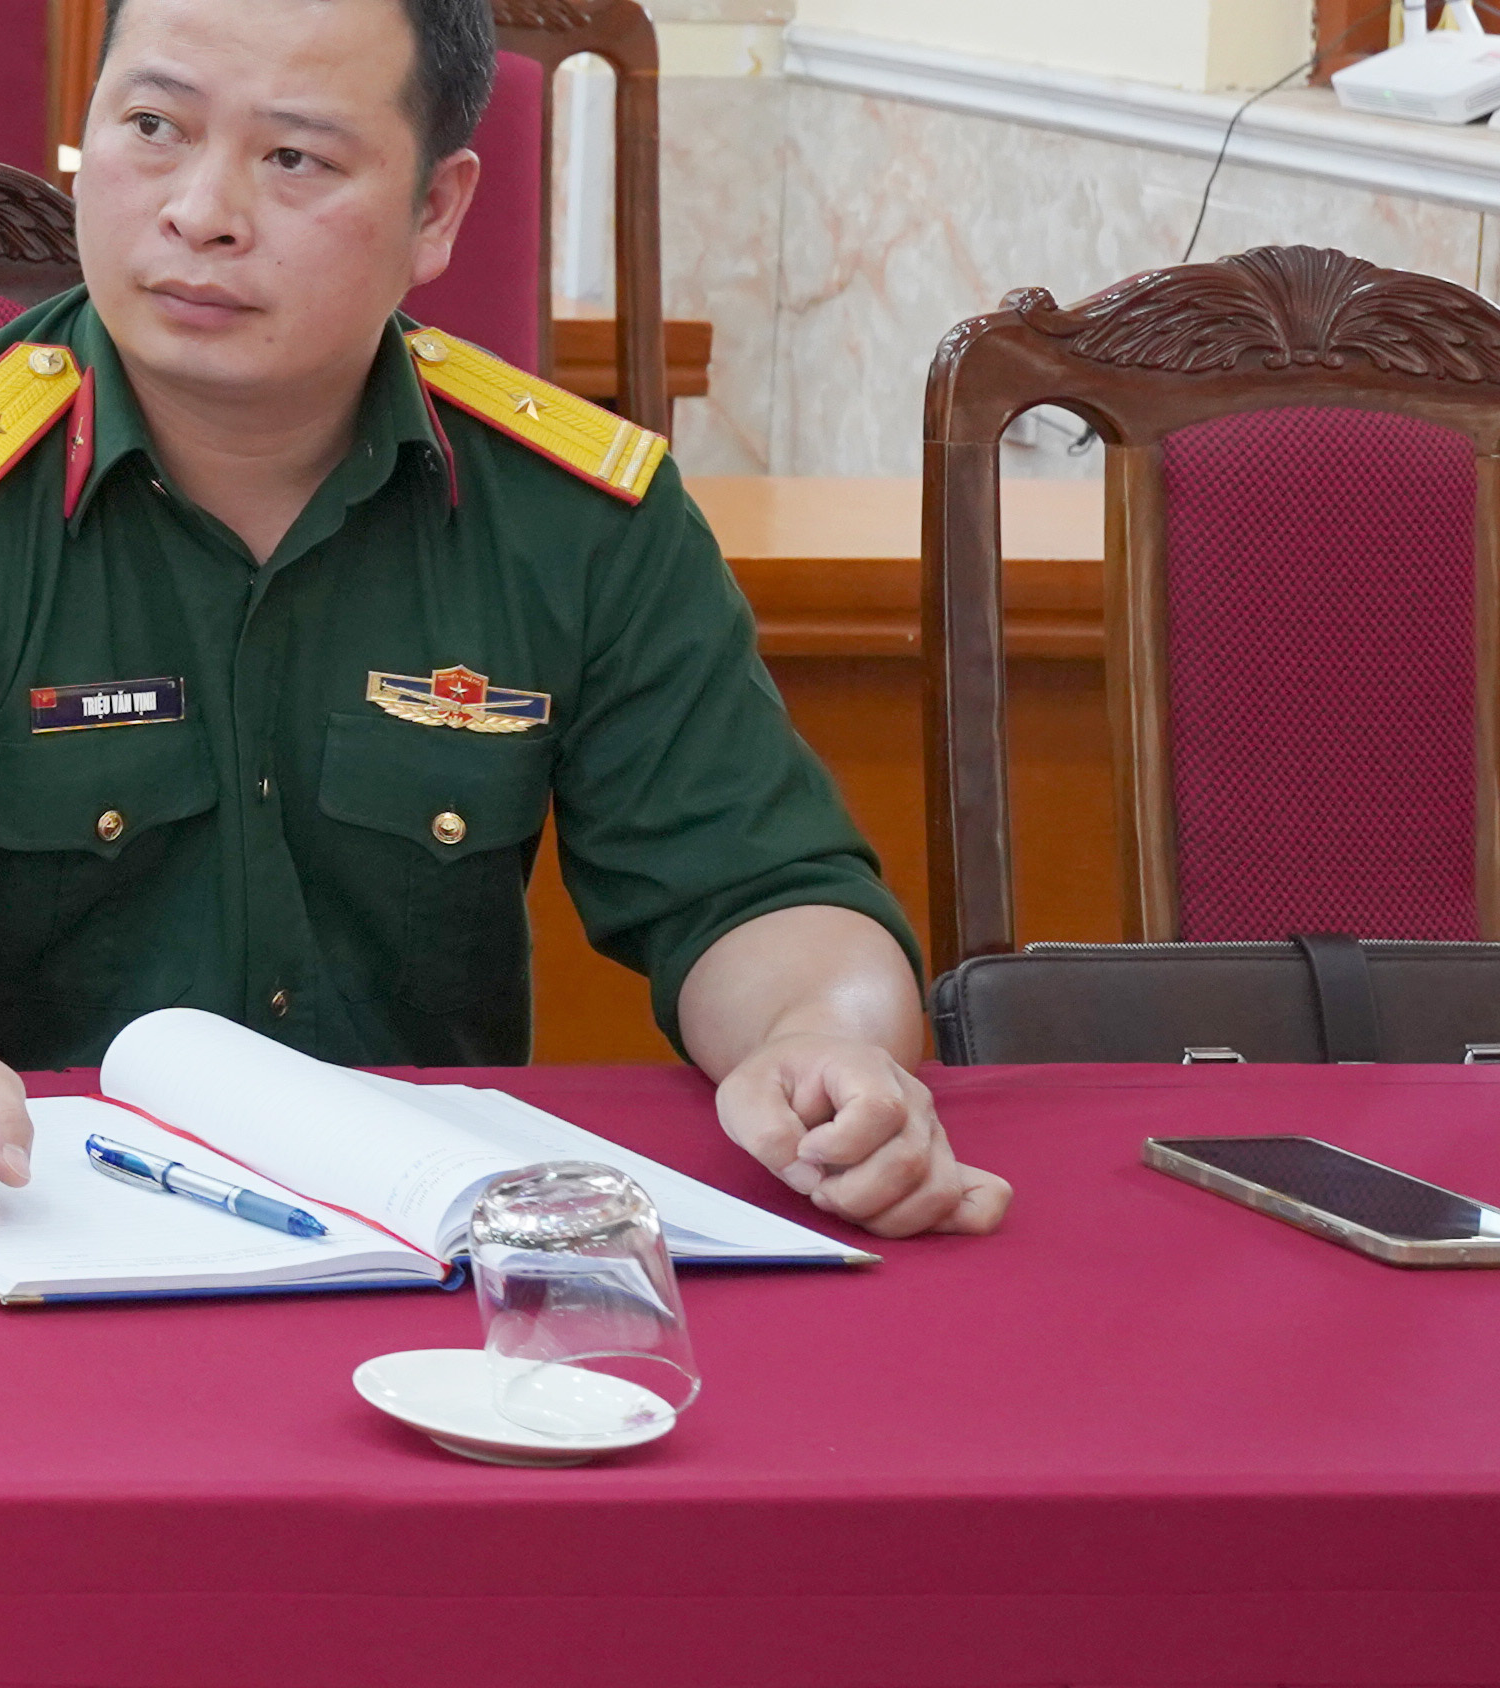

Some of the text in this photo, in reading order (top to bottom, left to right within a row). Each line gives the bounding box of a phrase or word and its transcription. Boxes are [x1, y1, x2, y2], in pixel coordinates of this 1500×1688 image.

[81, 689, 157, 719] TRIỆU VĂN VỊNH
